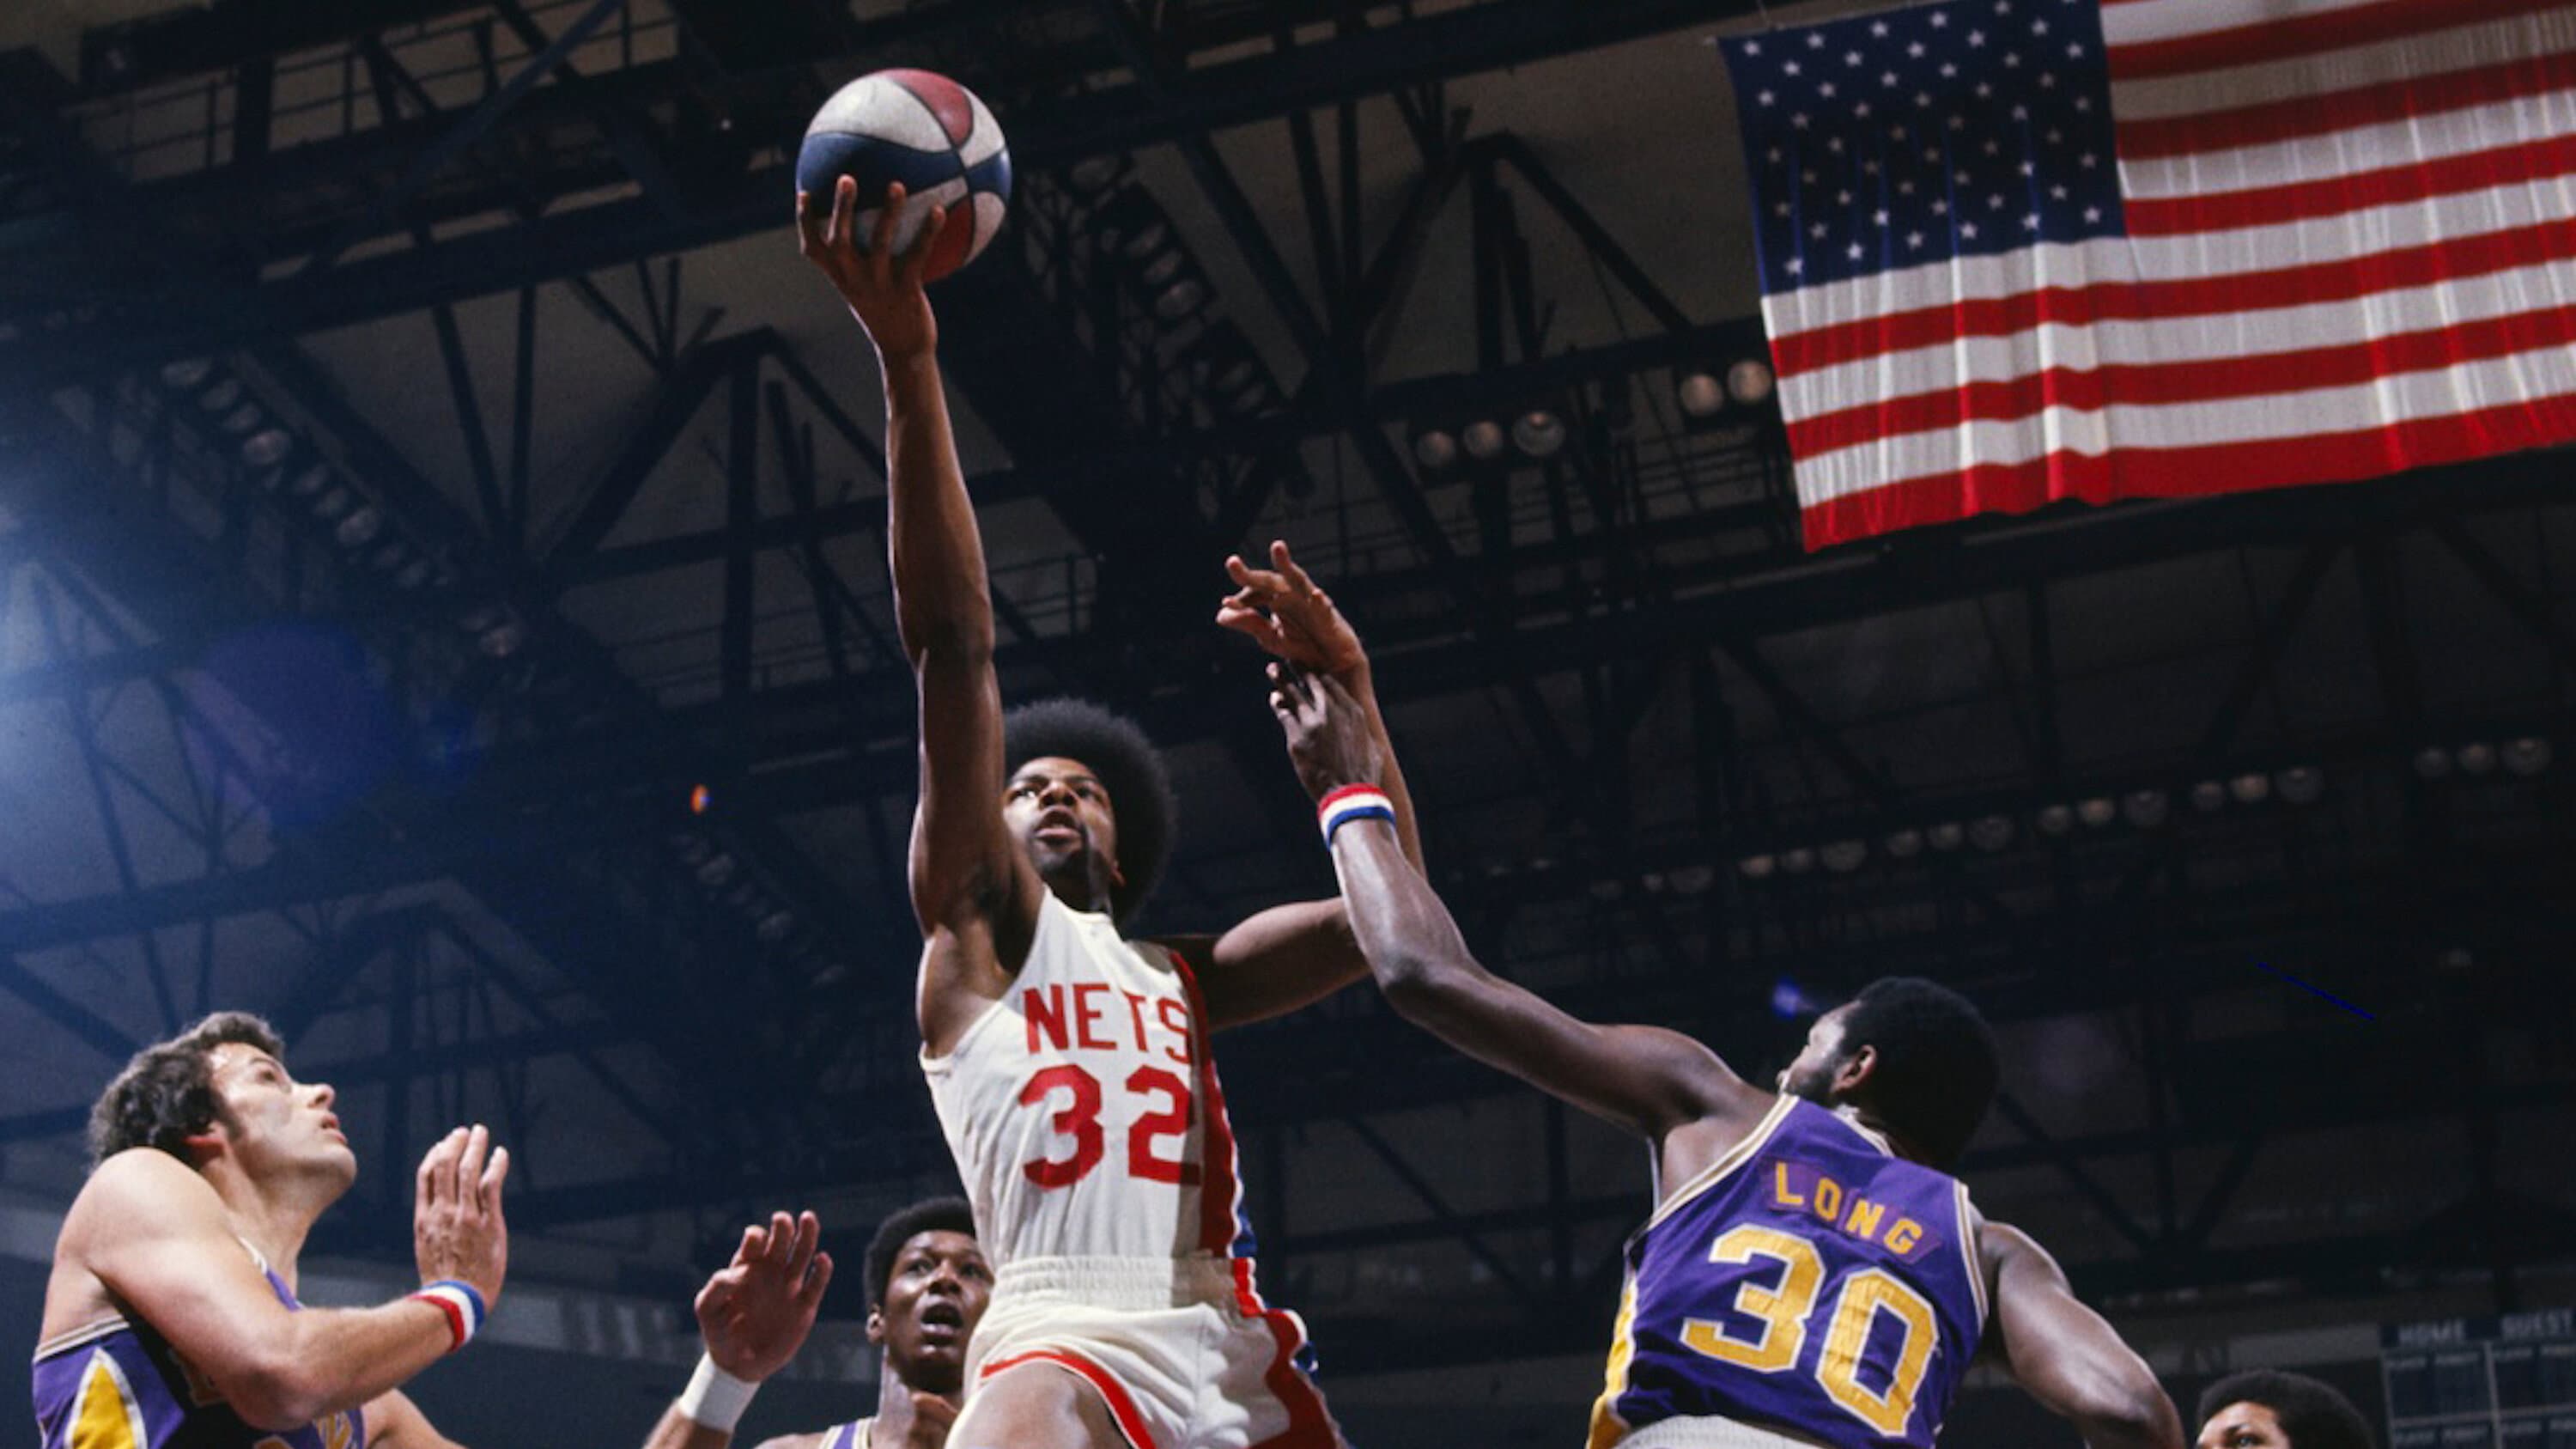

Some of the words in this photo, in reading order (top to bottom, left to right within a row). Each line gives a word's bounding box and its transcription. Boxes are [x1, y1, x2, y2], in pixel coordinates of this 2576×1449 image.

[1022, 983, 1192, 1064] NETS
[1018, 1063, 1200, 1192] 32
[1774, 1161, 1923, 1254] LONG
[1679, 1222, 1940, 1438] 30
[2397, 1318, 2464, 1343] HOME
